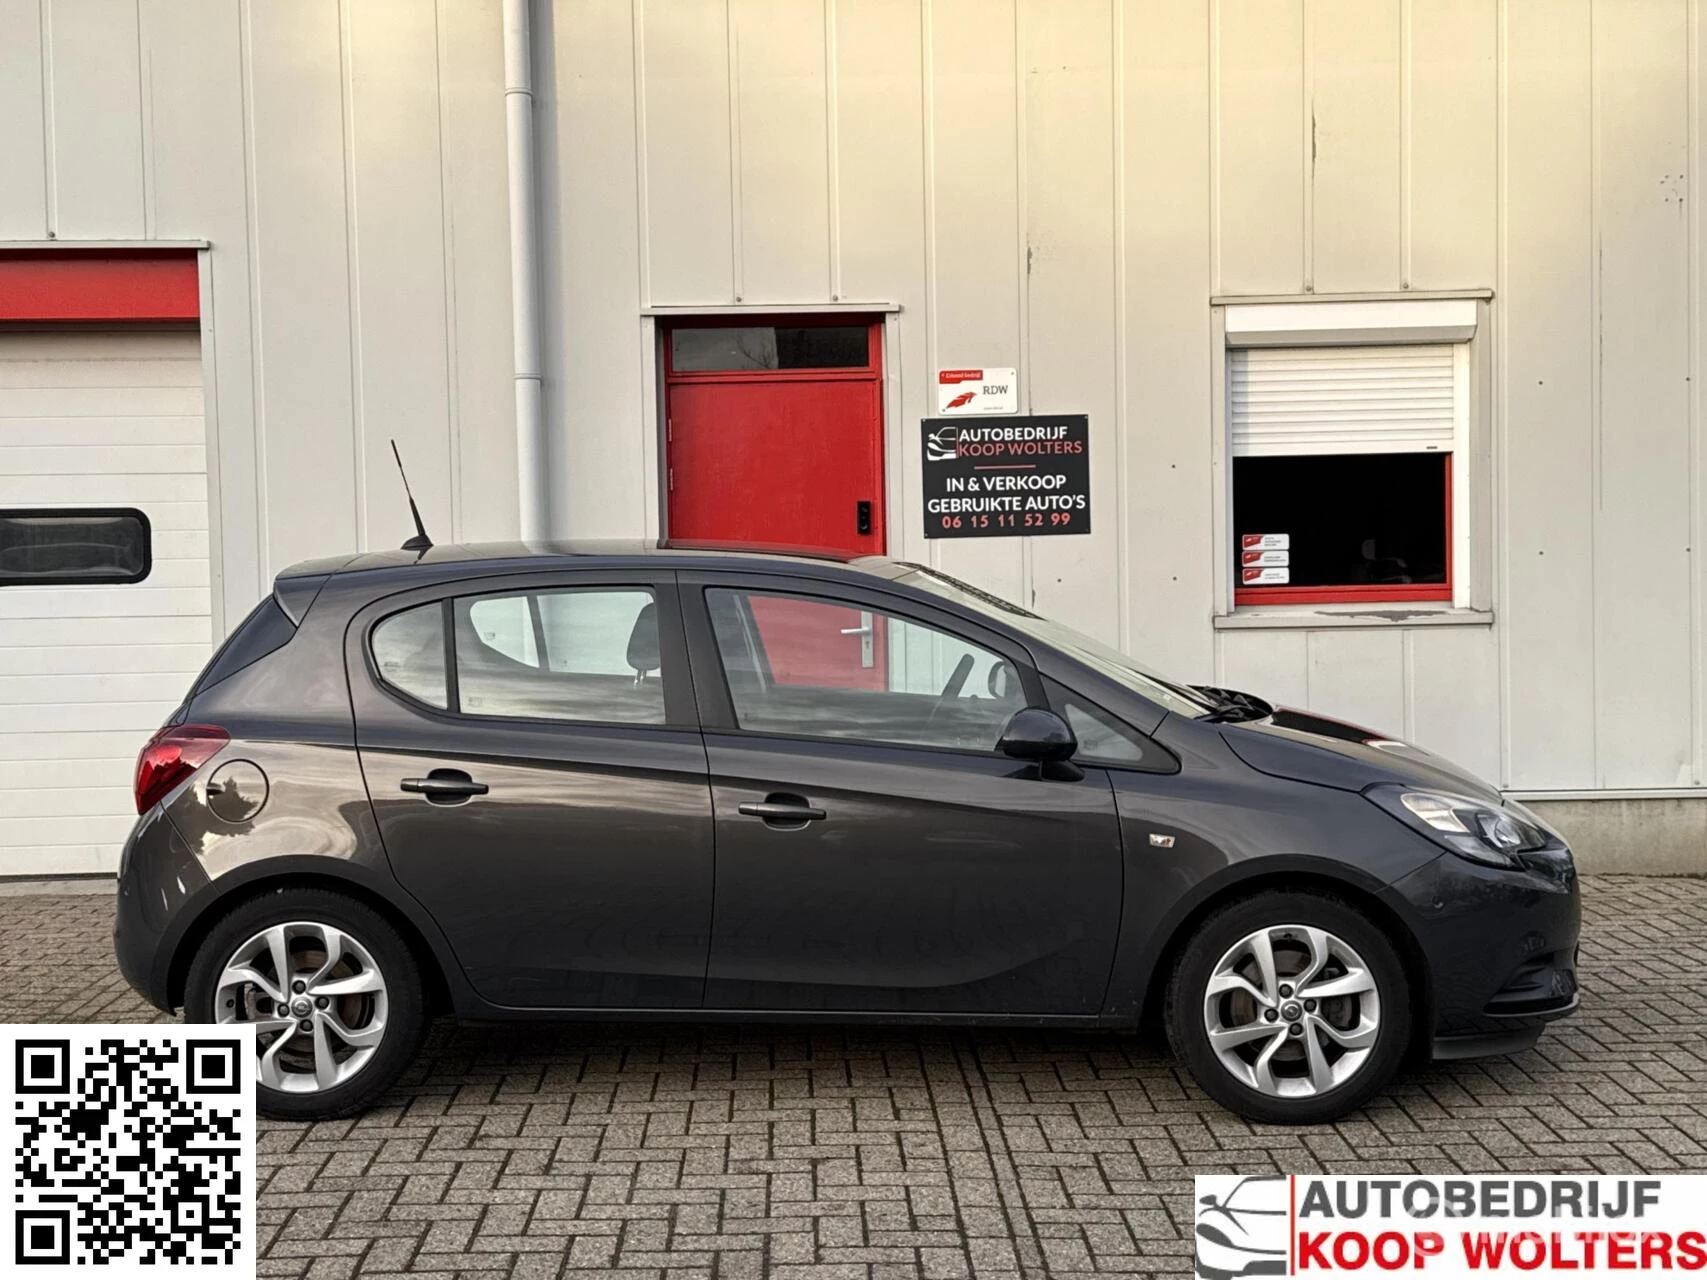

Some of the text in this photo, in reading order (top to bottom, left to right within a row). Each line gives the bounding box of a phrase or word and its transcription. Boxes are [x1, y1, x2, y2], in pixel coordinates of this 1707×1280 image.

[983, 385, 1009, 395] RDW
[959, 426, 1068, 442] AUTOBEDRIJF
[959, 441, 1083, 457] KOOP WOLTERS
[946, 475, 1067, 492] IN & VERKOOP
[927, 494, 1086, 513] GEBRUIKTE AUTO'S
[942, 512, 1071, 528] 06 15 11 52 99
